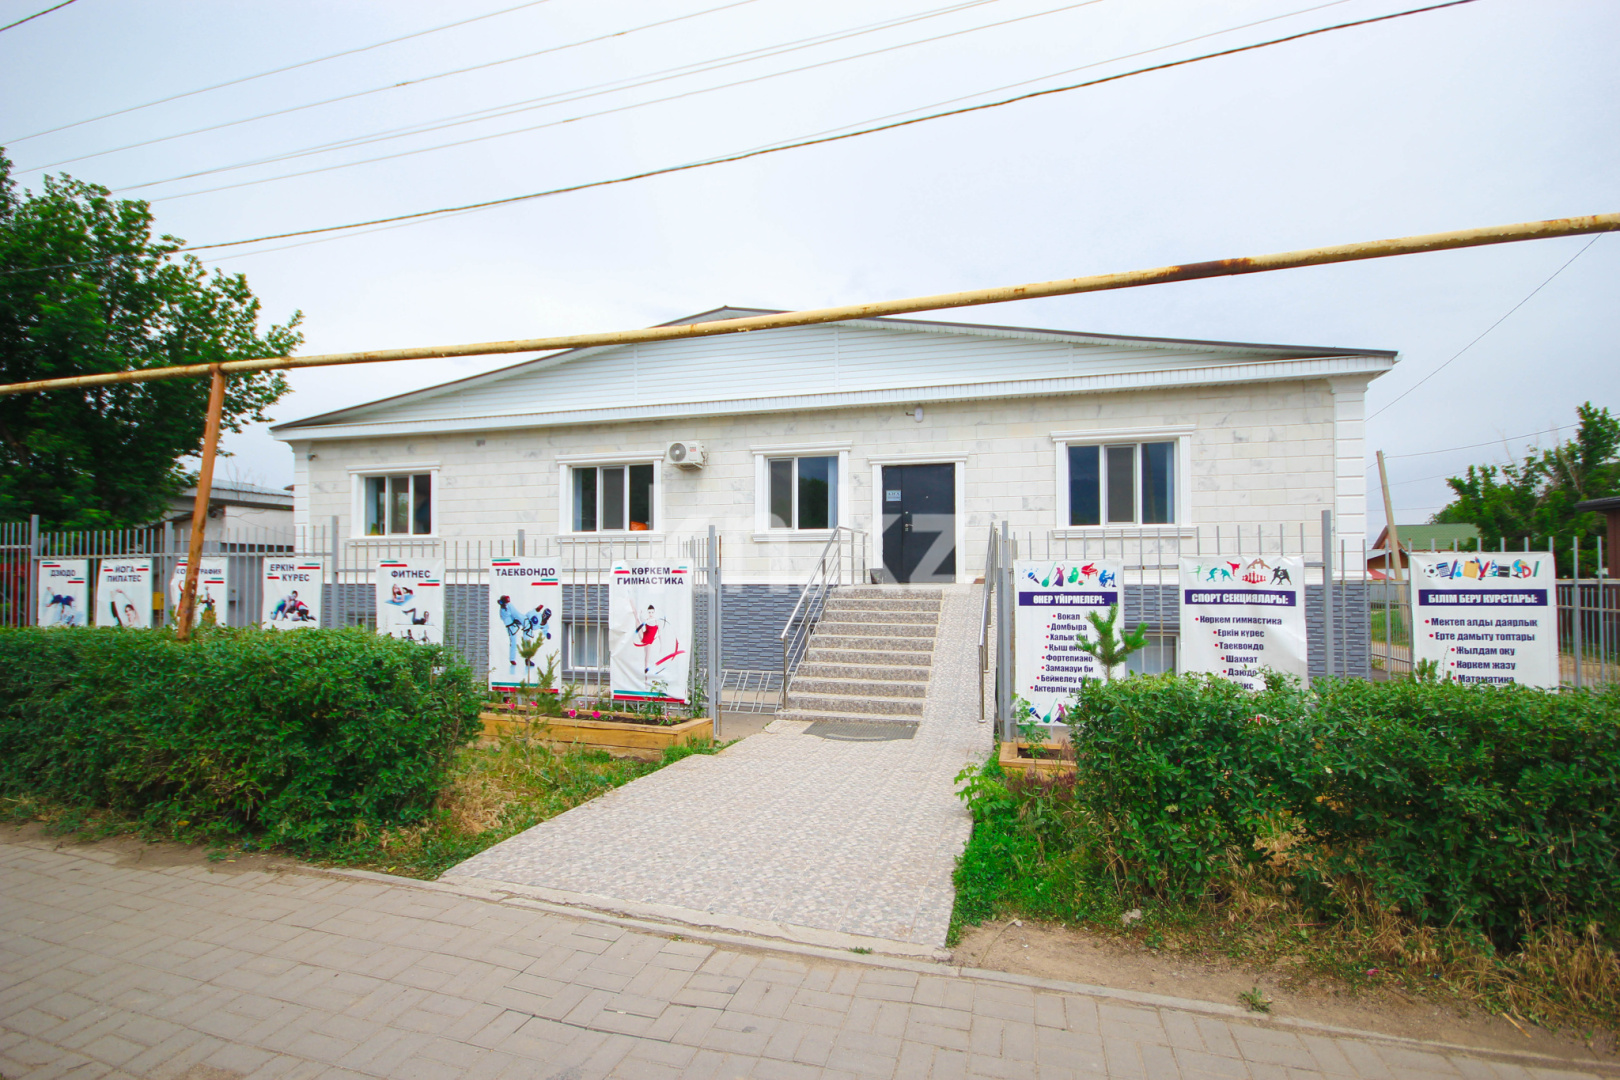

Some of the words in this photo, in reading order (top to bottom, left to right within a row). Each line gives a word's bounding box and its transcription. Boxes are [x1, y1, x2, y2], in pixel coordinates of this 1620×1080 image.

[115, 565, 135, 573] ЙОГА
[270, 563, 295, 572] ЕРКІН
[631, 566, 671, 575] КӨРКЕМ
[50, 569, 76, 577] ДЗЮДО
[391, 569, 431, 579] ФИТНЕС
[495, 567, 556, 578] ТАЕКВОНДО
[107, 574, 142, 582] ПИЛАТЕС
[617, 576, 684, 586] ГИМНАСТИКА
[1033, 595, 1053, 604] ӨНЕР
[1192, 593, 1221, 603] СПОРТ
[1223, 593, 1289, 605] СЕКЦИЯЛАРЫ:
[1428, 594, 1457, 604] БІЛІМ
[1459, 594, 1481, 604] БЕРУ
[1483, 594, 1538, 604] КУРСТАРЫ:
[1200, 616, 1231, 625] Көркем
[1232, 617, 1283, 626] гимнастика
[1431, 618, 1465, 626] Мектеп
[1467, 619, 1493, 627] алды
[1051, 623, 1087, 632] Домбыра
[1217, 629, 1240, 637] Еркін
[1435, 632, 1455, 641] Ерте
[1457, 633, 1494, 641] дамыту
[1495, 633, 1535, 642] топтары
[1219, 642, 1264, 651] Таеквондо
[1456, 646, 1497, 655] Жылдам
[1046, 654, 1093, 663] Фортепиано
[1226, 655, 1258, 663] Шахмат
[1045, 665, 1083, 673] Заманауи
[1084, 665, 1094, 673] би
[1492, 662, 1516, 670] жазу
[1228, 668, 1257, 677] Дзюдо
[1041, 675, 1077, 683] Бейнелеу
[1458, 674, 1514, 683] Математика
[1034, 685, 1068, 693] Актерлік
[1233, 681, 1254, 690] кс
